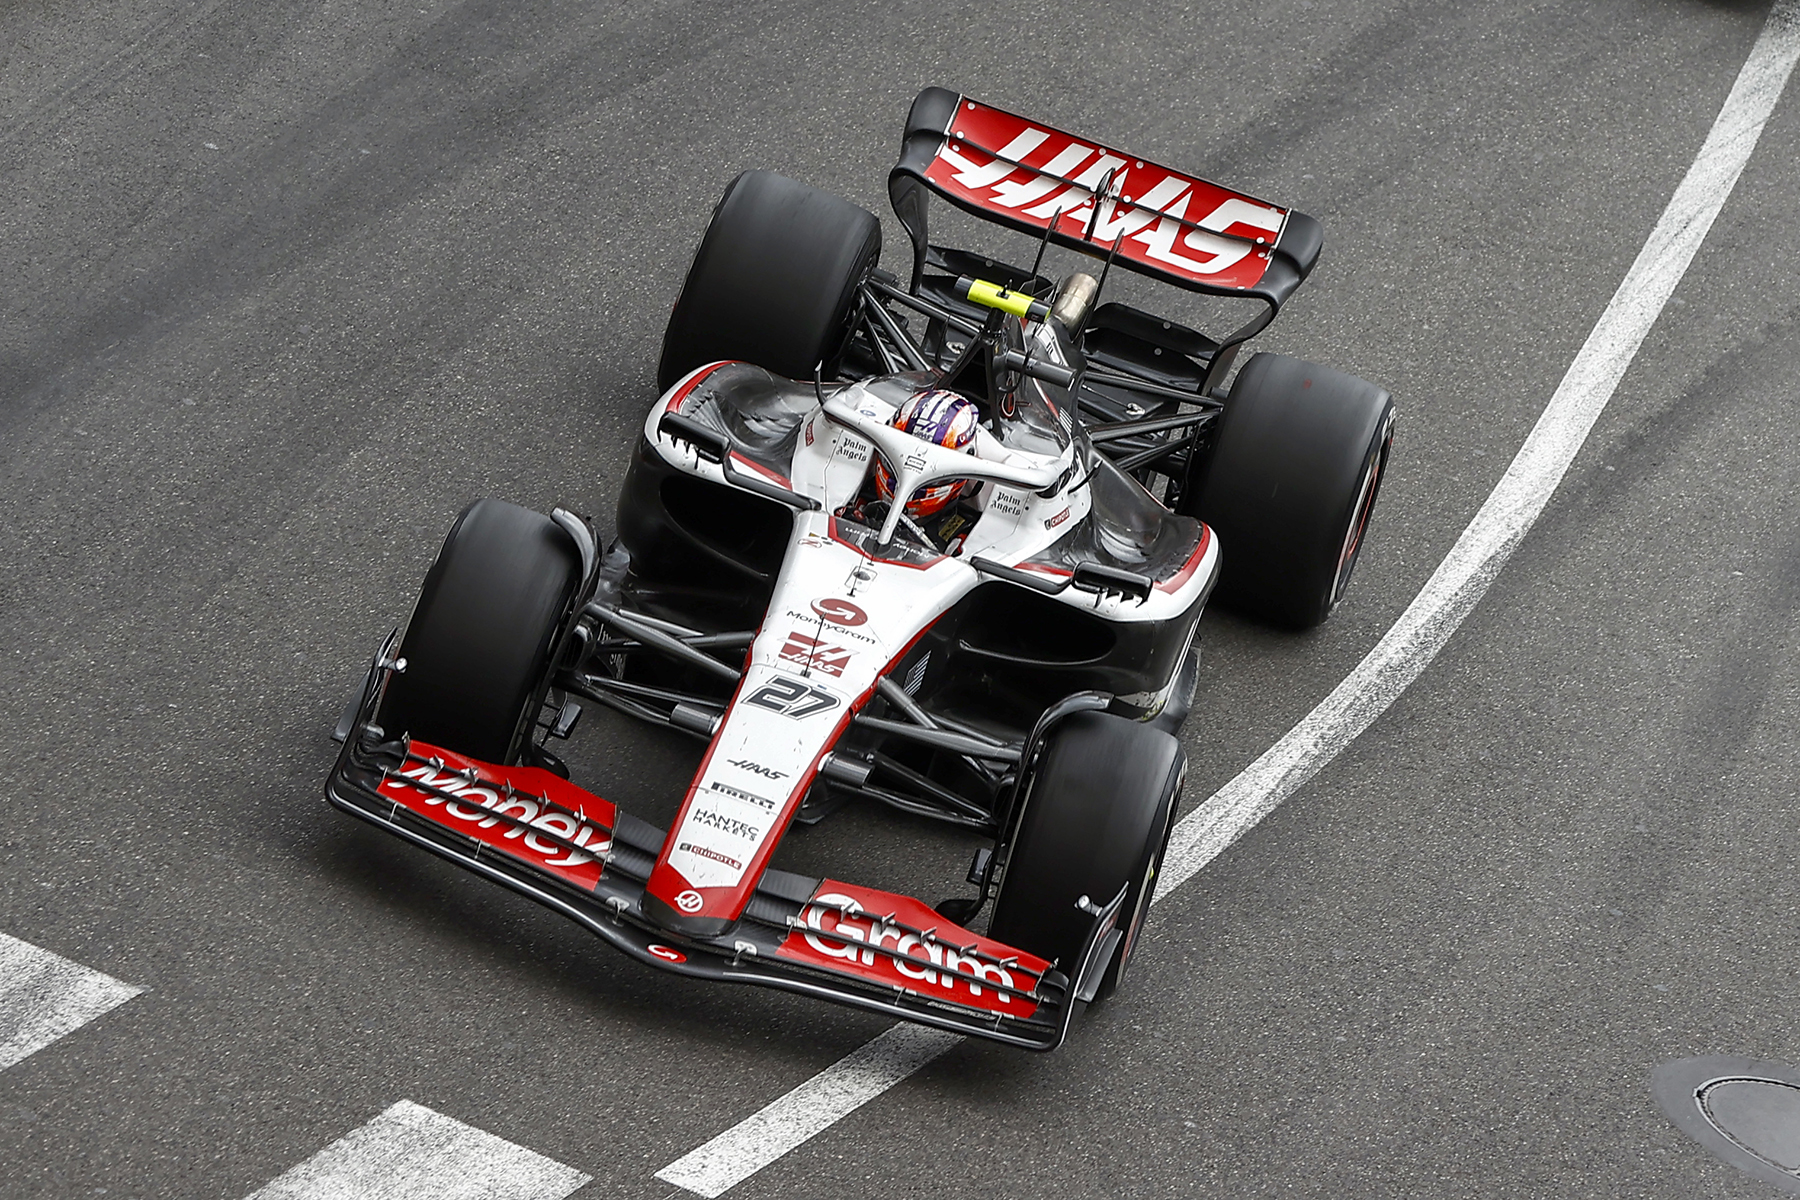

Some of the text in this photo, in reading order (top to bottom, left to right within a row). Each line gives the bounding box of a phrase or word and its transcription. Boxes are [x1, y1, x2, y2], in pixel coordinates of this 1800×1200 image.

[937, 127, 1287, 274] HAAS
[836, 445, 867, 461] Angels
[844, 437, 867, 452] Palm
[991, 501, 1021, 516] Angels
[997, 491, 1021, 506] Palm
[780, 652, 844, 672] HAAS
[741, 675, 841, 720] 27
[727, 759, 789, 779] HAAS
[711, 781, 775, 809] PIRELLI
[388, 760, 613, 867] Money
[696, 808, 759, 836] HANTEC
[693, 815, 757, 841] MARKETS
[692, 846, 741, 869] CHIPOTLE
[804, 893, 1015, 1003] Gram
